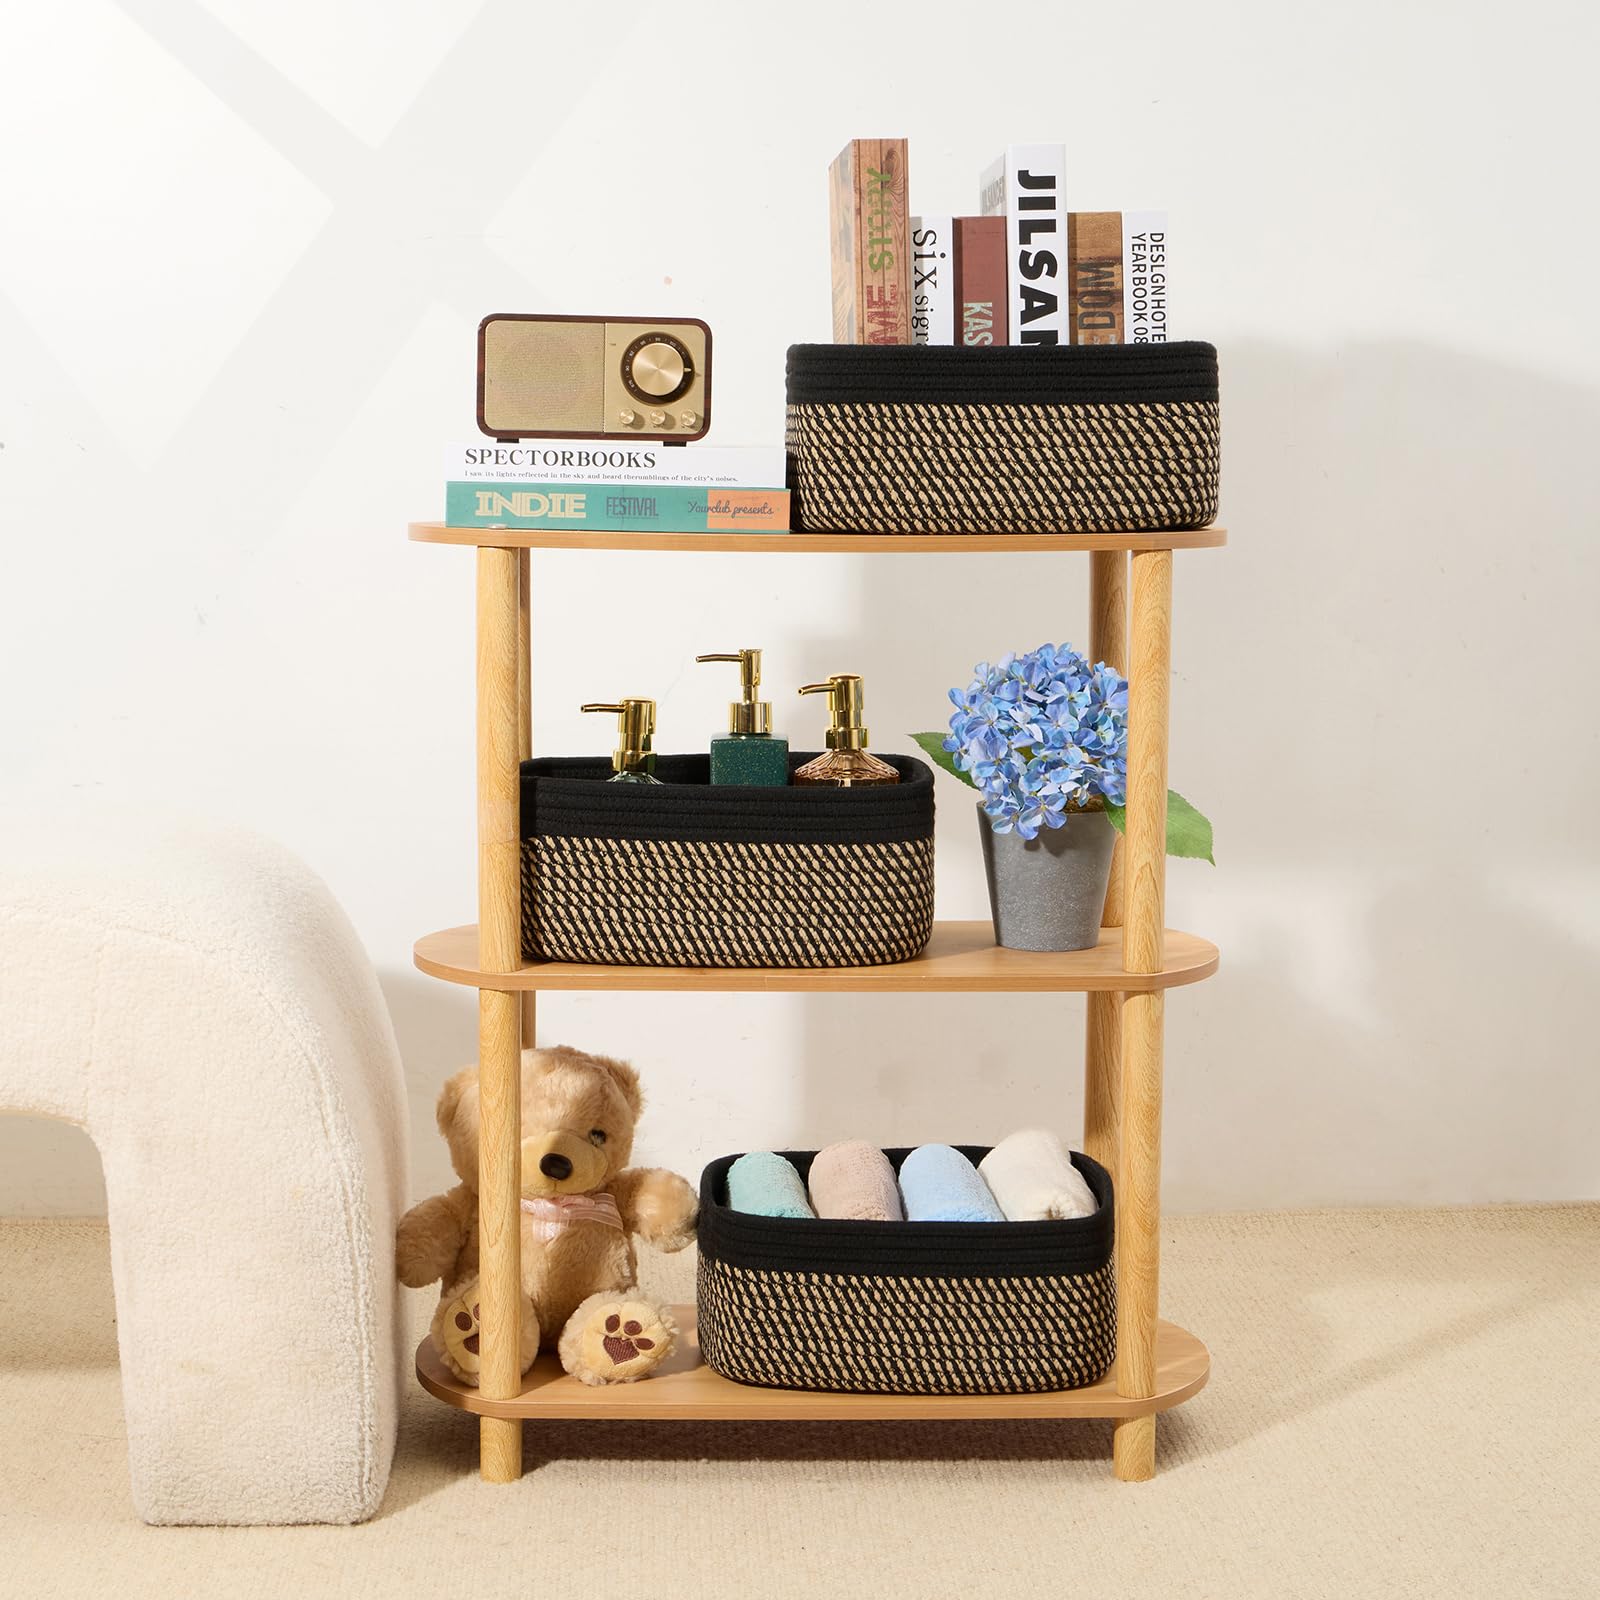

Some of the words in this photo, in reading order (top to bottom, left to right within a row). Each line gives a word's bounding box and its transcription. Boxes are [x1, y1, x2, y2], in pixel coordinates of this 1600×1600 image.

[866, 167, 894, 272] STORY
[1132, 232, 1147, 273] YEAR
[1133, 277, 1148, 322] BOOK
[963, 302, 993, 346] KAS
[465, 448, 656, 469] SPECTORBOOKS
[475, 491, 586, 518] INDIE
[606, 496, 659, 516] FESTIVAL
[731, 502, 774, 518] presents
